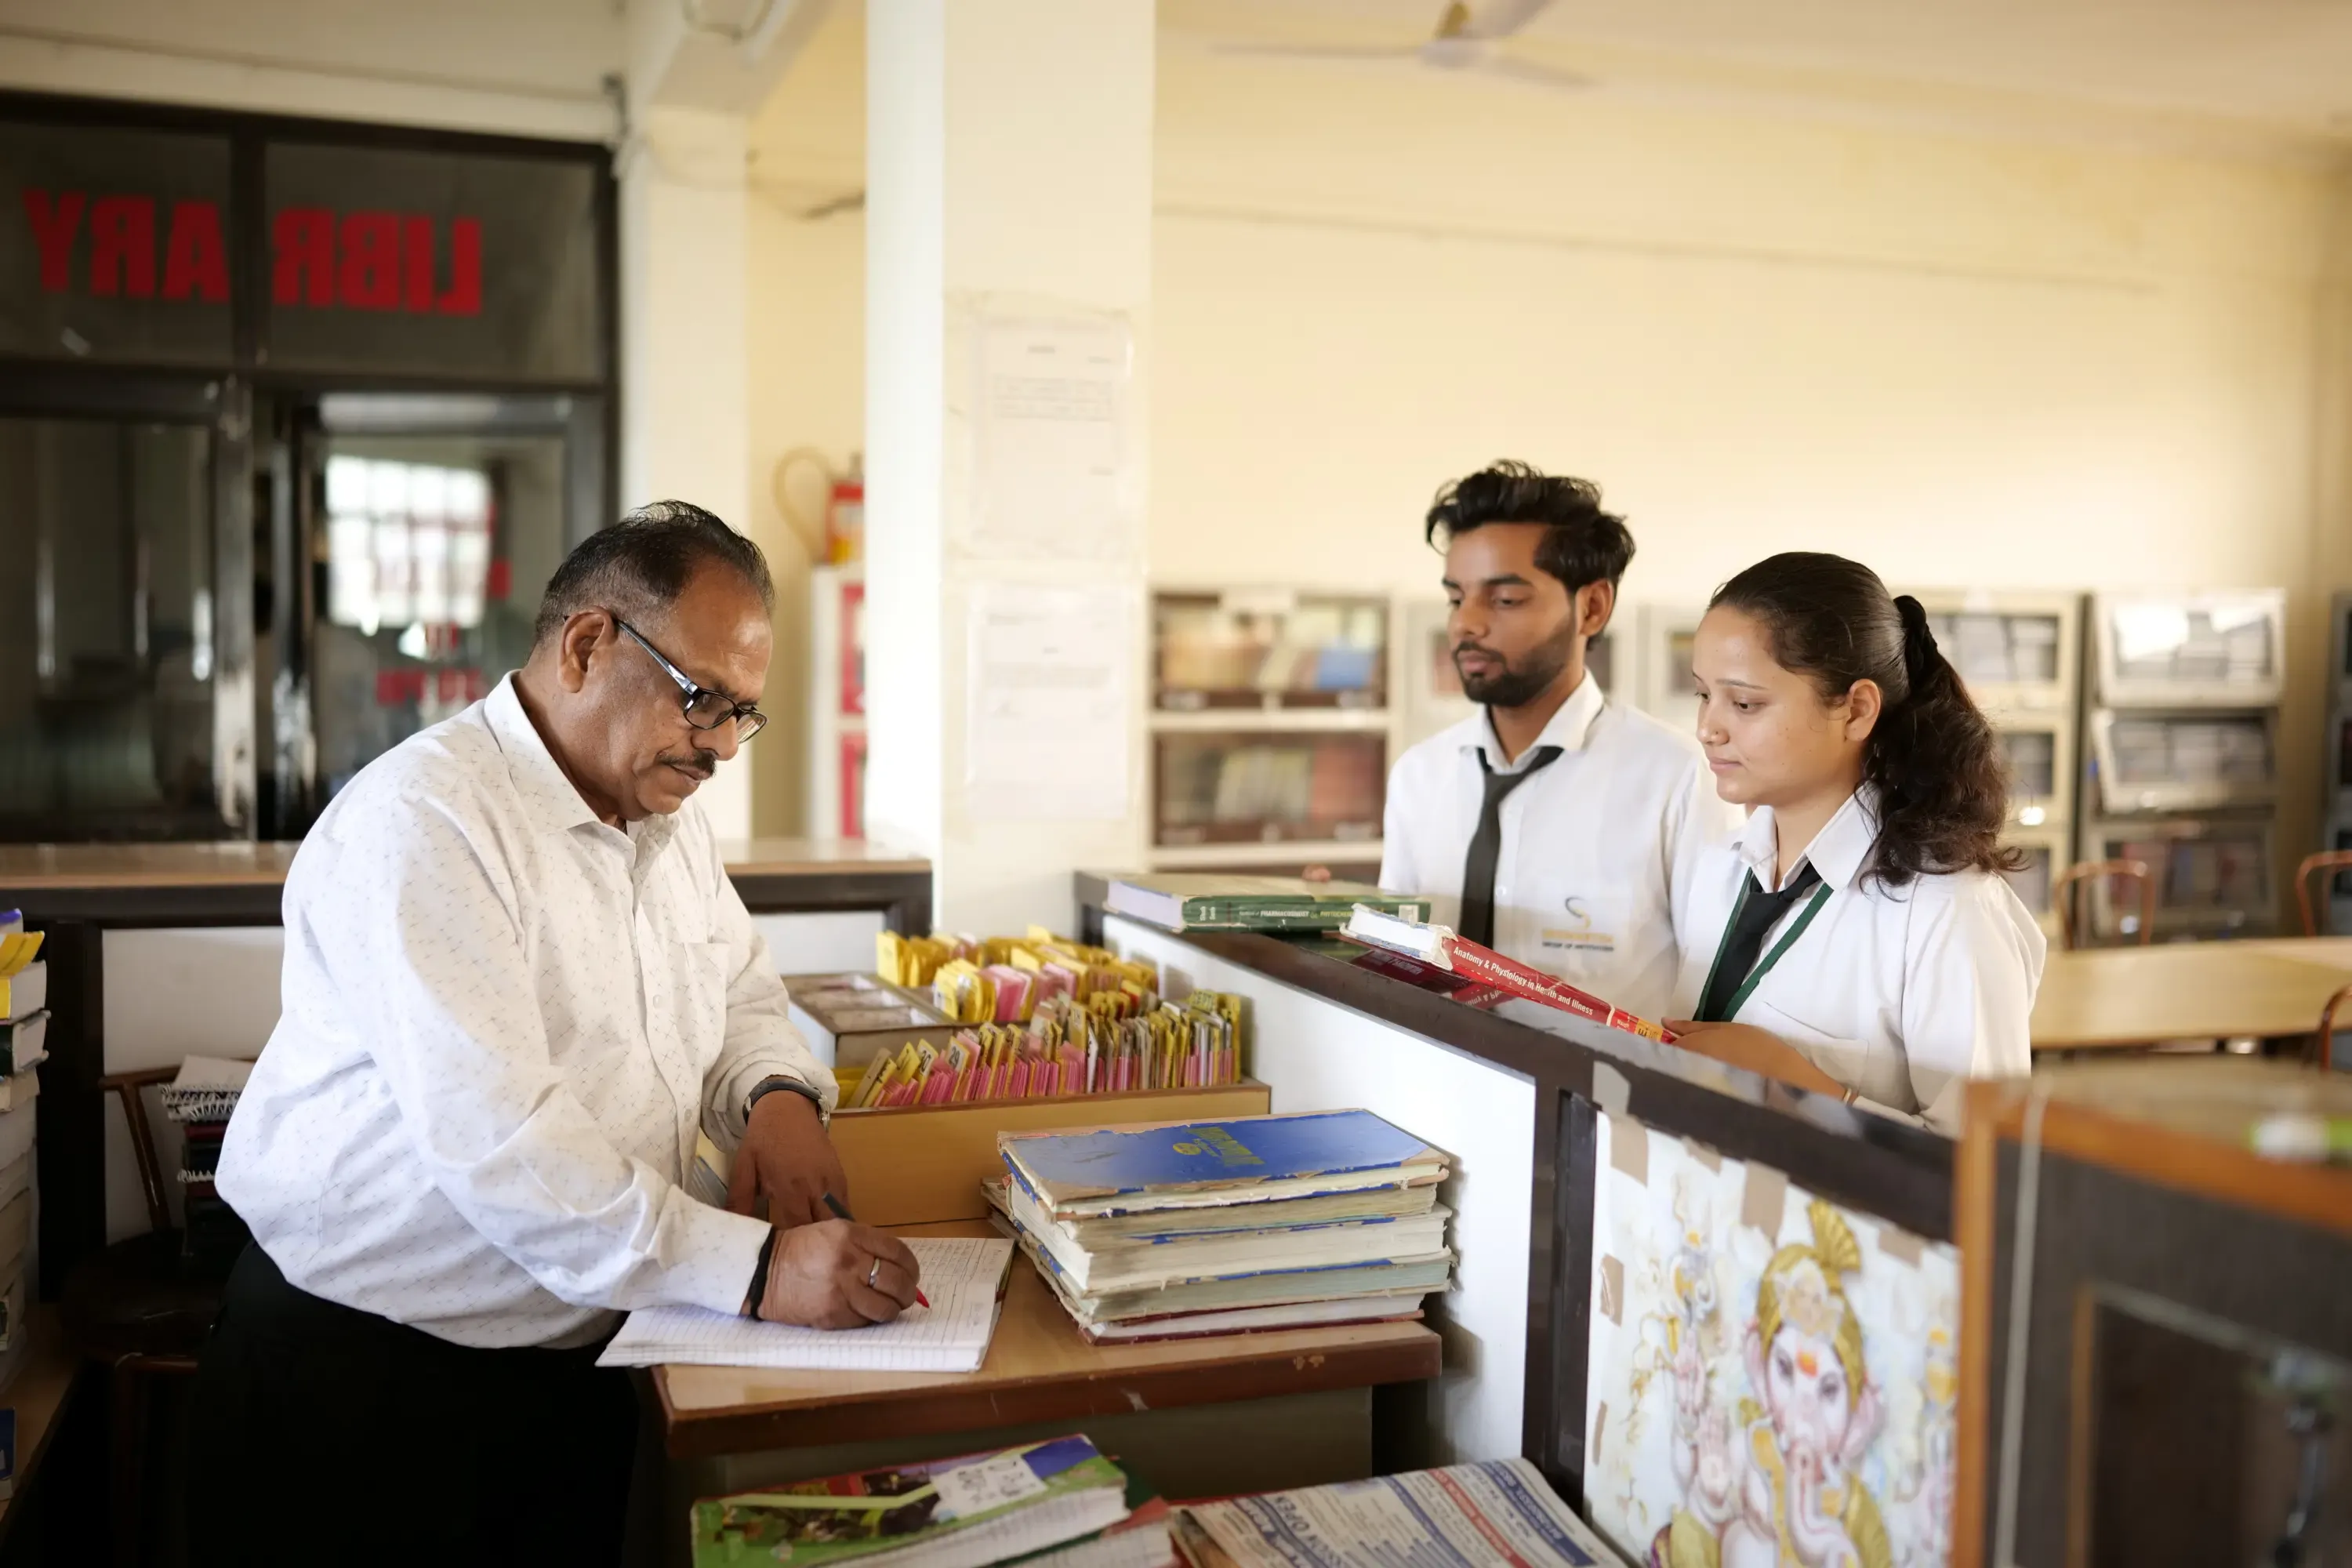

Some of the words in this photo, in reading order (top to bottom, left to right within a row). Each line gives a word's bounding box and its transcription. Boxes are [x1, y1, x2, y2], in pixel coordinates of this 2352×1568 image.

[1454, 946, 1483, 967] Anatomy
[1483, 959, 1490, 968] &
[1490, 963, 1527, 985] Physiology
[1527, 978, 1535, 989] in
[1558, 993, 1571, 1005] and
[1571, 997, 1594, 1016] Illness
